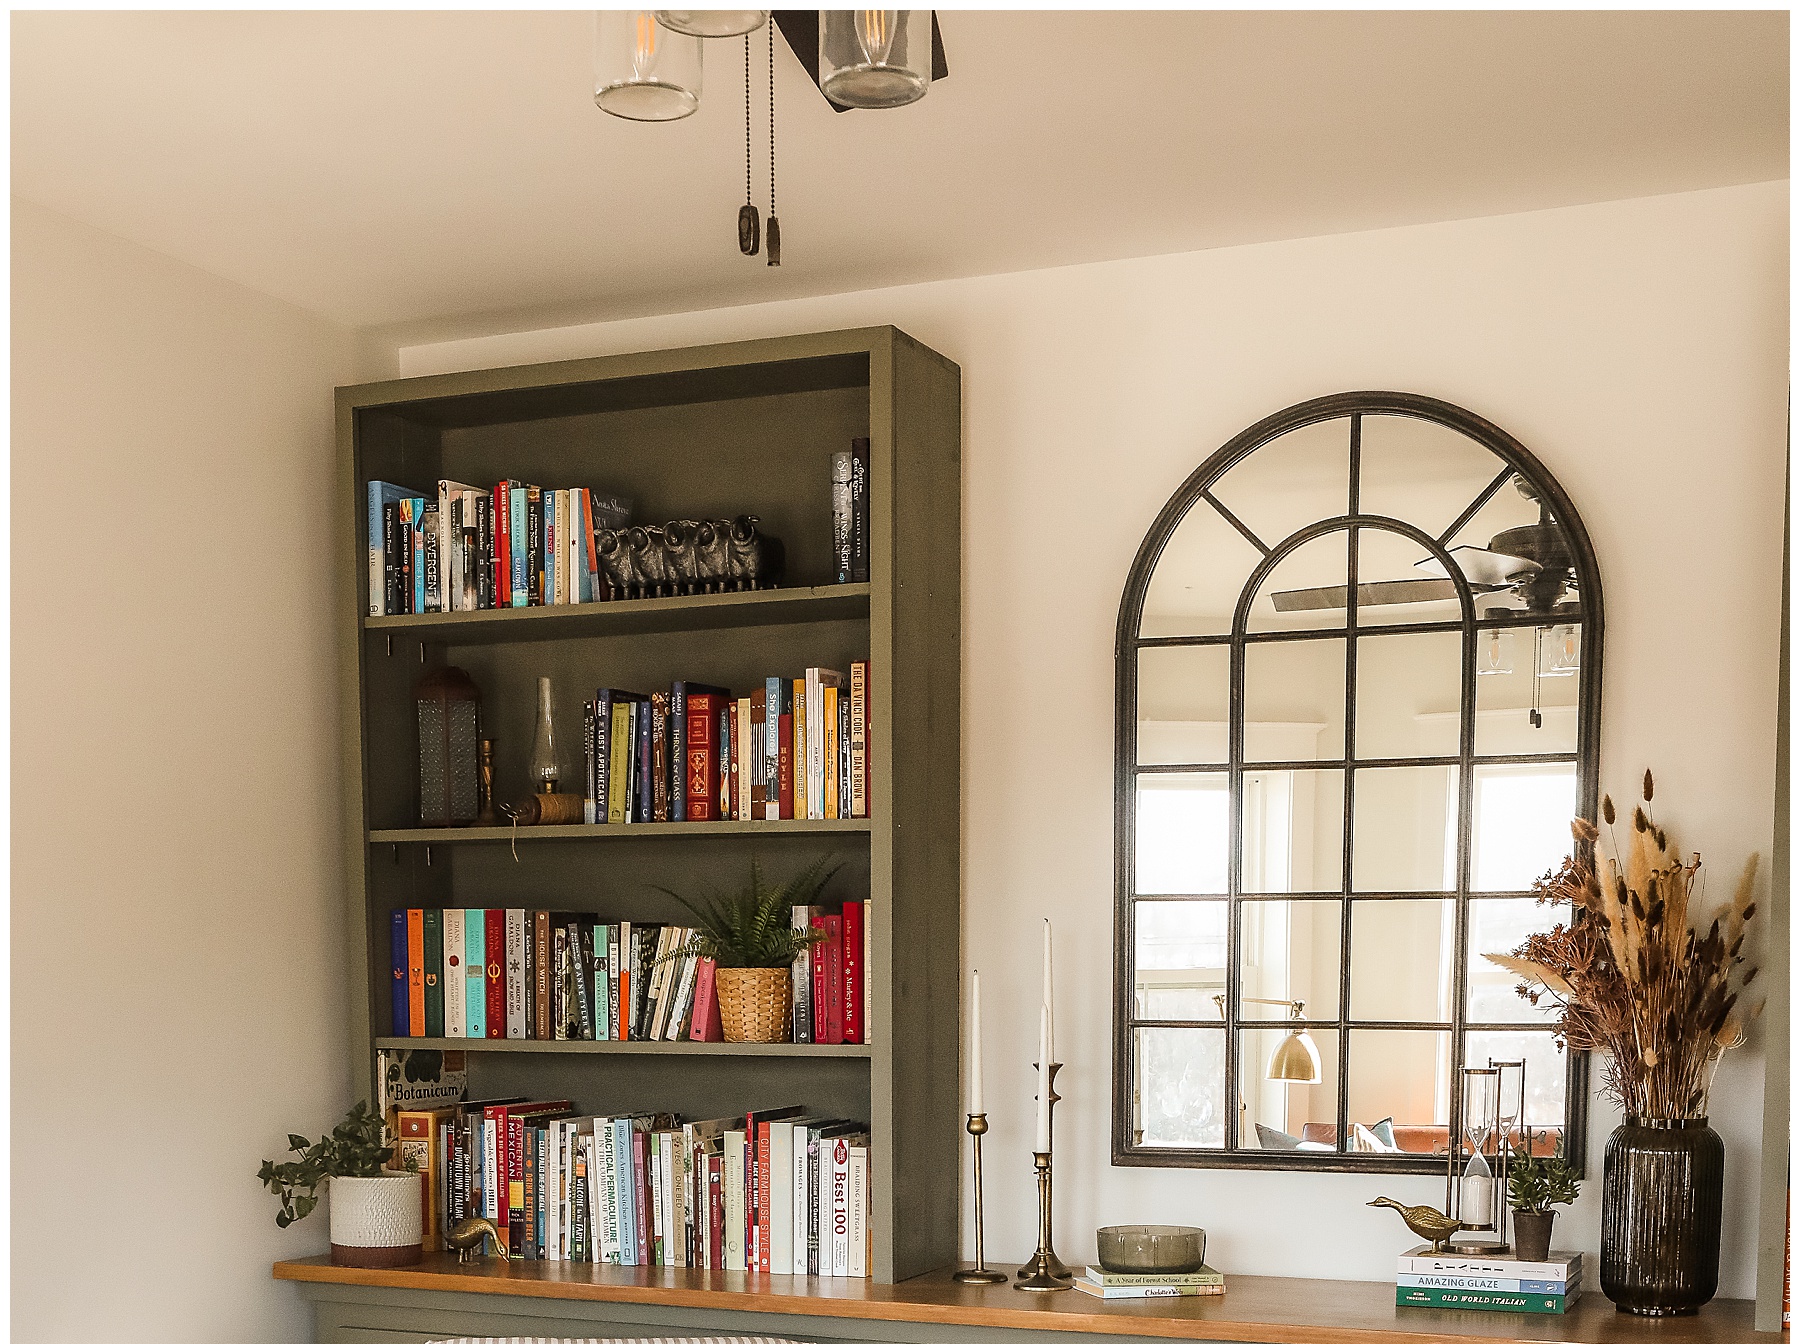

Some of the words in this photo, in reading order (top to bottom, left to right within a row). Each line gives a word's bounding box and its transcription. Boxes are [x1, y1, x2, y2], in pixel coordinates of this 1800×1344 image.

[840, 512, 848, 539] WINGS
[427, 532, 437, 598] DIVERGENT
[840, 544, 850, 571] NIGHT
[853, 666, 862, 680] THE
[853, 682, 862, 692] DA
[769, 694, 777, 712] She
[853, 694, 863, 715] VINCI
[853, 717, 863, 736] CODE
[853, 756, 863, 771] DAN
[853, 773, 863, 799] BROWN
[844, 976, 853, 1002] Marley
[580, 999, 588, 1027] TYLER
[846, 1009, 853, 1022] Me
[394, 1083, 459, 1101] Botanicum
[508, 1122, 516, 1177] MEXICAN
[598, 1139, 605, 1148] IN
[604, 1125, 614, 1174] PRACTICAL
[618, 1140, 626, 1160] Zones
[760, 1137, 769, 1160] CITY
[454, 1146, 463, 1190] DOWNTOWN
[619, 1160, 627, 1193] American
[525, 1173, 533, 1195] DRINK
[760, 1162, 769, 1222] FARMHOUSE
[834, 1171, 846, 1204] Best
[455, 1192, 463, 1219] ITALIAN
[525, 1196, 533, 1222] BETTER
[606, 1174, 618, 1243] PERMACULTURE
[525, 1223, 534, 1242] BEER
[834, 1207, 847, 1235] 100
[760, 1223, 770, 1254] STYLE
[1418, 1277, 1465, 1287] AMAZING
[1468, 1278, 1499, 1289] GLAZE
[1441, 1294, 1458, 1302] OLD
[1460, 1295, 1489, 1304] WORLD
[1491, 1297, 1527, 1306] ITALIAN
